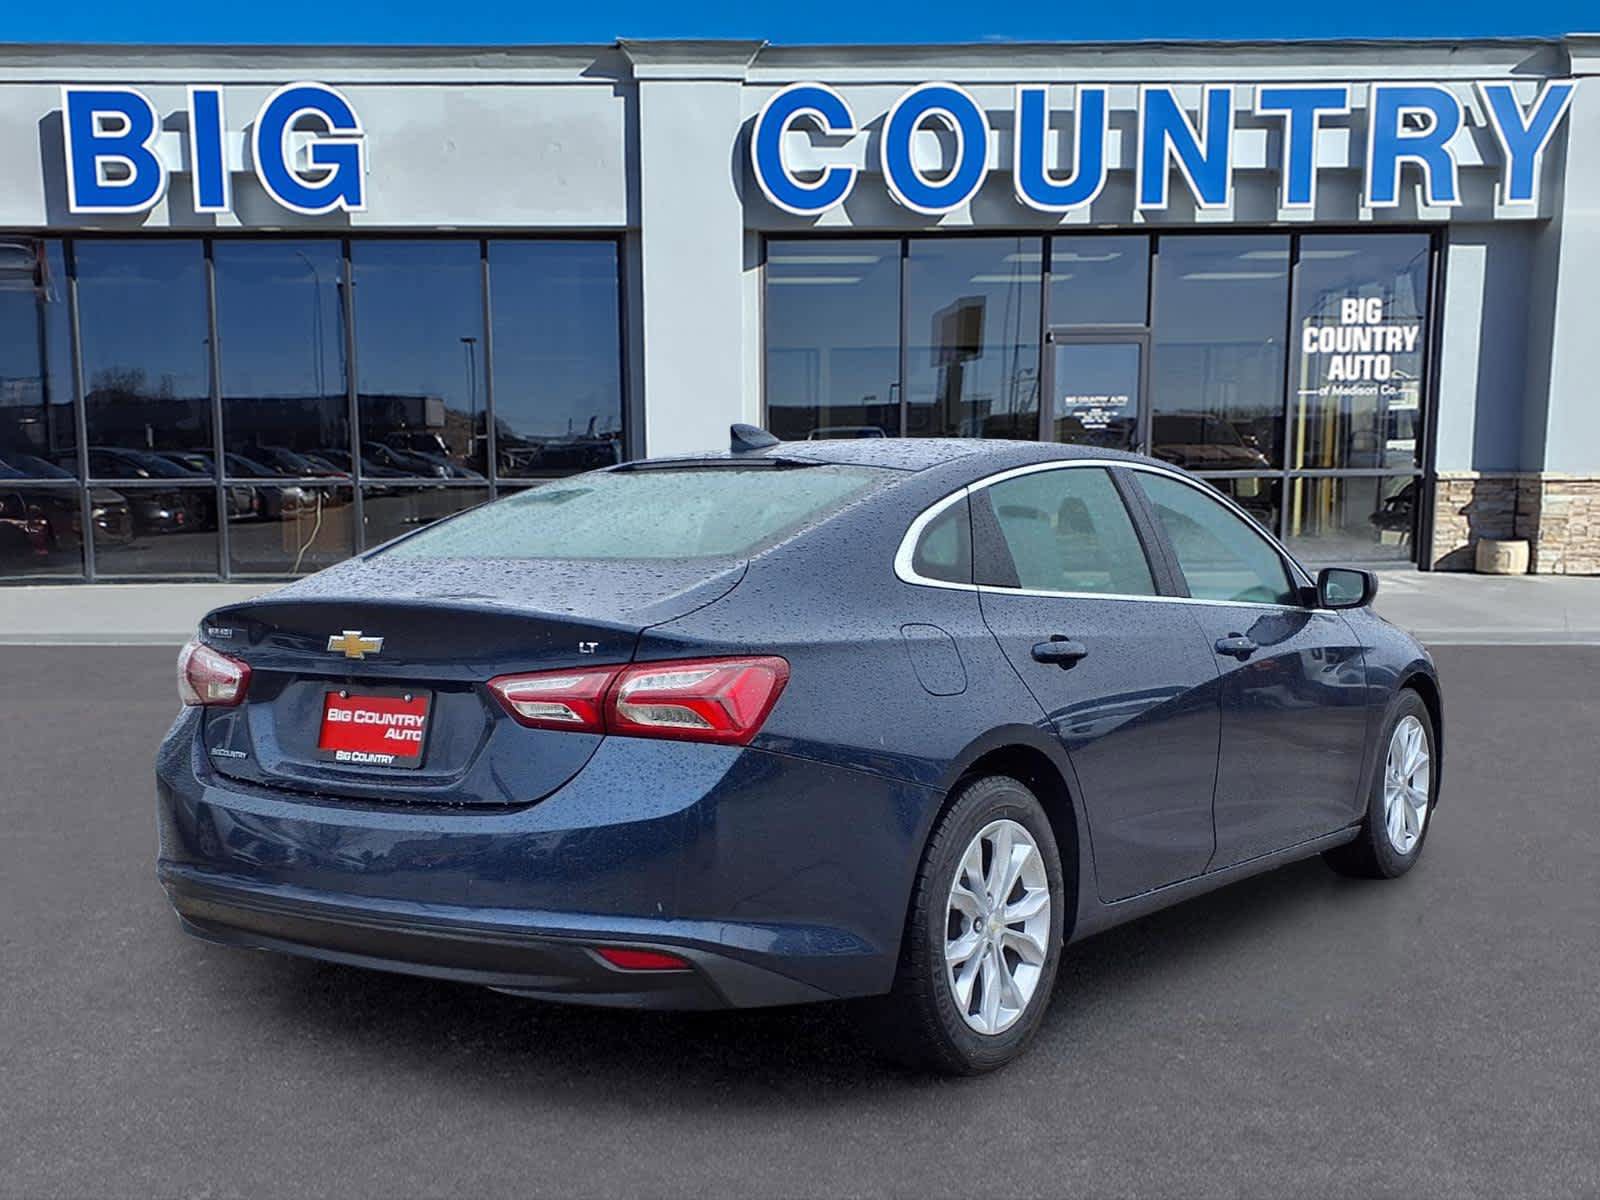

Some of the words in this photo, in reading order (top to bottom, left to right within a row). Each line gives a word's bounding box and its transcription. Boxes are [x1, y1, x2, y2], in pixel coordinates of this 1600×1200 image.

[61, 82, 367, 215] BIG
[751, 81, 1574, 216] COUNTRY
[1341, 297, 1383, 325] BIG
[1303, 326, 1419, 353] COUNTRY
[1328, 355, 1392, 381] AUTO
[1331, 384, 1378, 397] Madison
[579, 641, 599, 654] LT
[327, 708, 352, 722] BIG
[354, 710, 425, 727] COUNTRY
[384, 728, 422, 741] AUTO
[336, 750, 351, 761] BIG
[352, 752, 395, 764] COUNTRY
